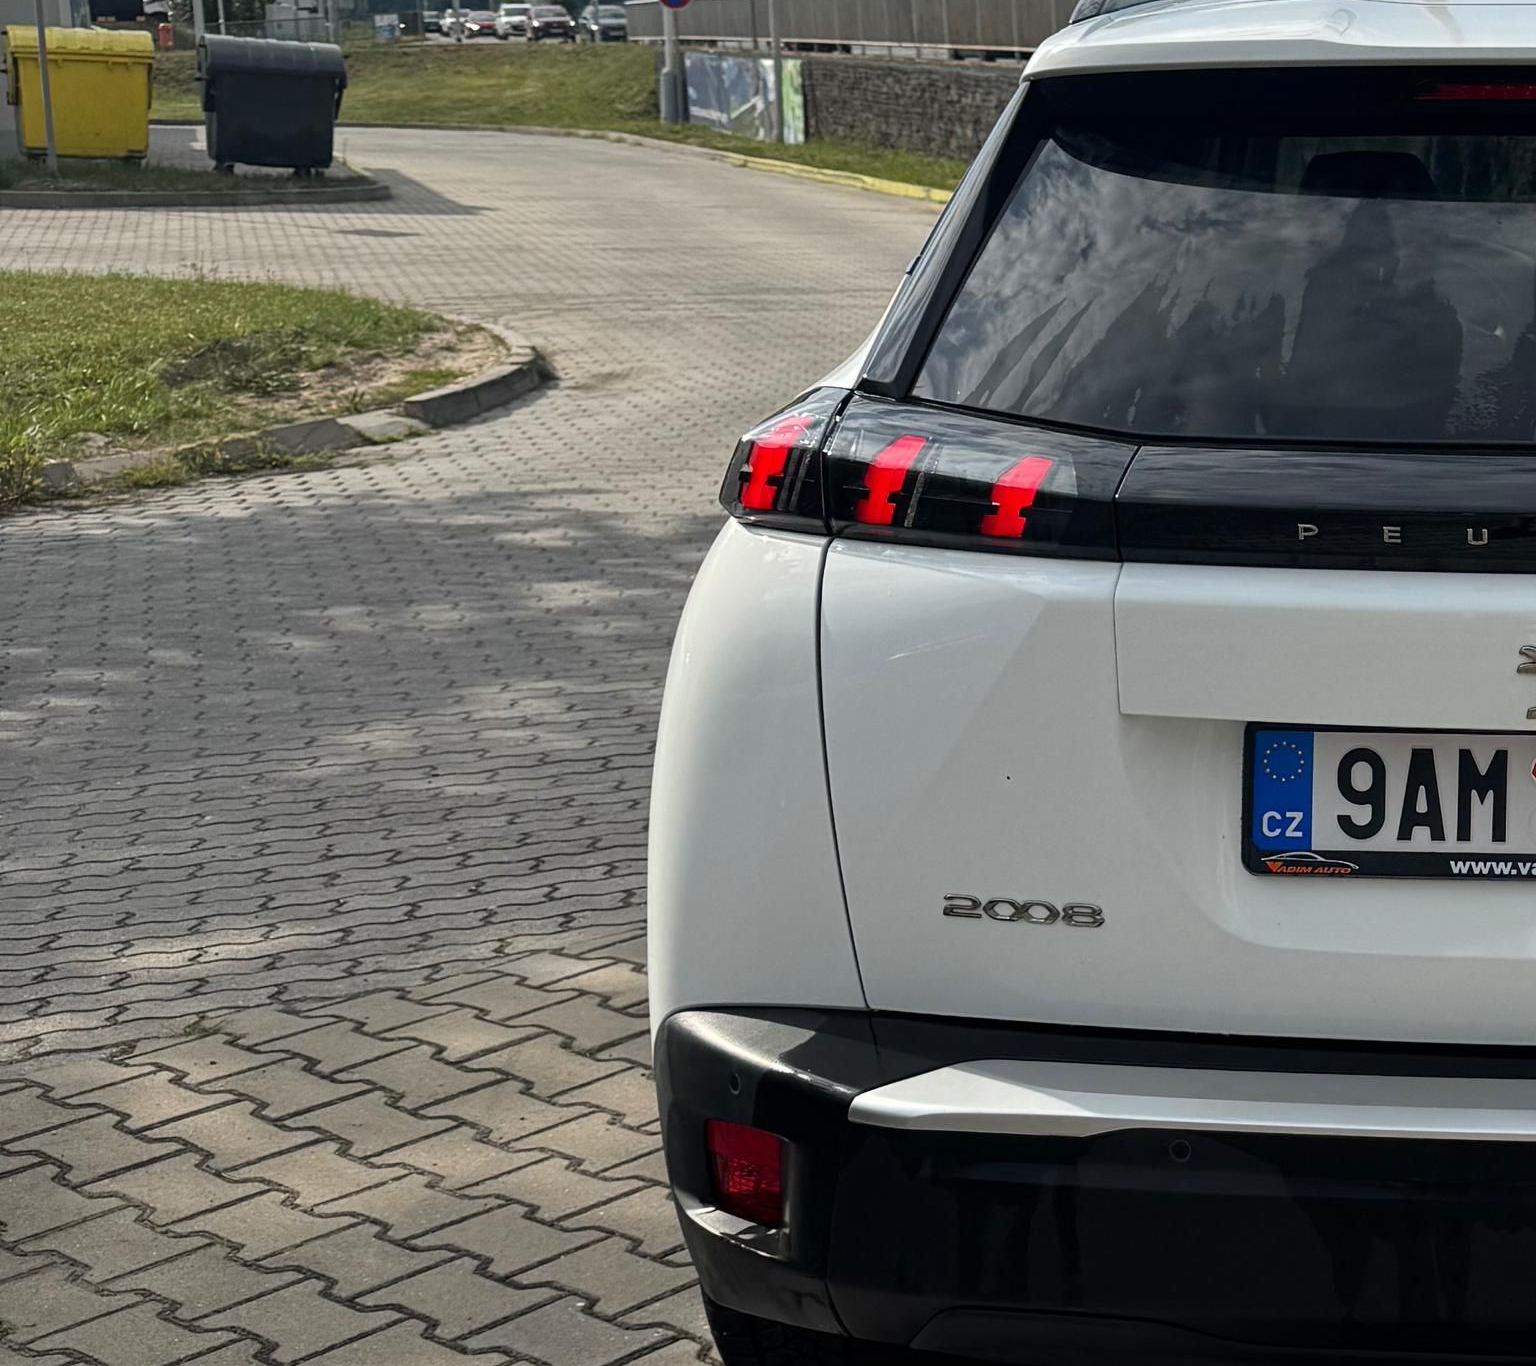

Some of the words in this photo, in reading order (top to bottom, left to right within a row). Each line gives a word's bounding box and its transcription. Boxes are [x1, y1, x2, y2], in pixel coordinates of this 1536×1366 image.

[1336, 747, 1508, 843] 9AM
[1261, 810, 1304, 838] CZ
[1265, 861, 1313, 874] VADIM
[1312, 866, 1352, 874] AUTO
[942, 892, 1106, 928] 2008
